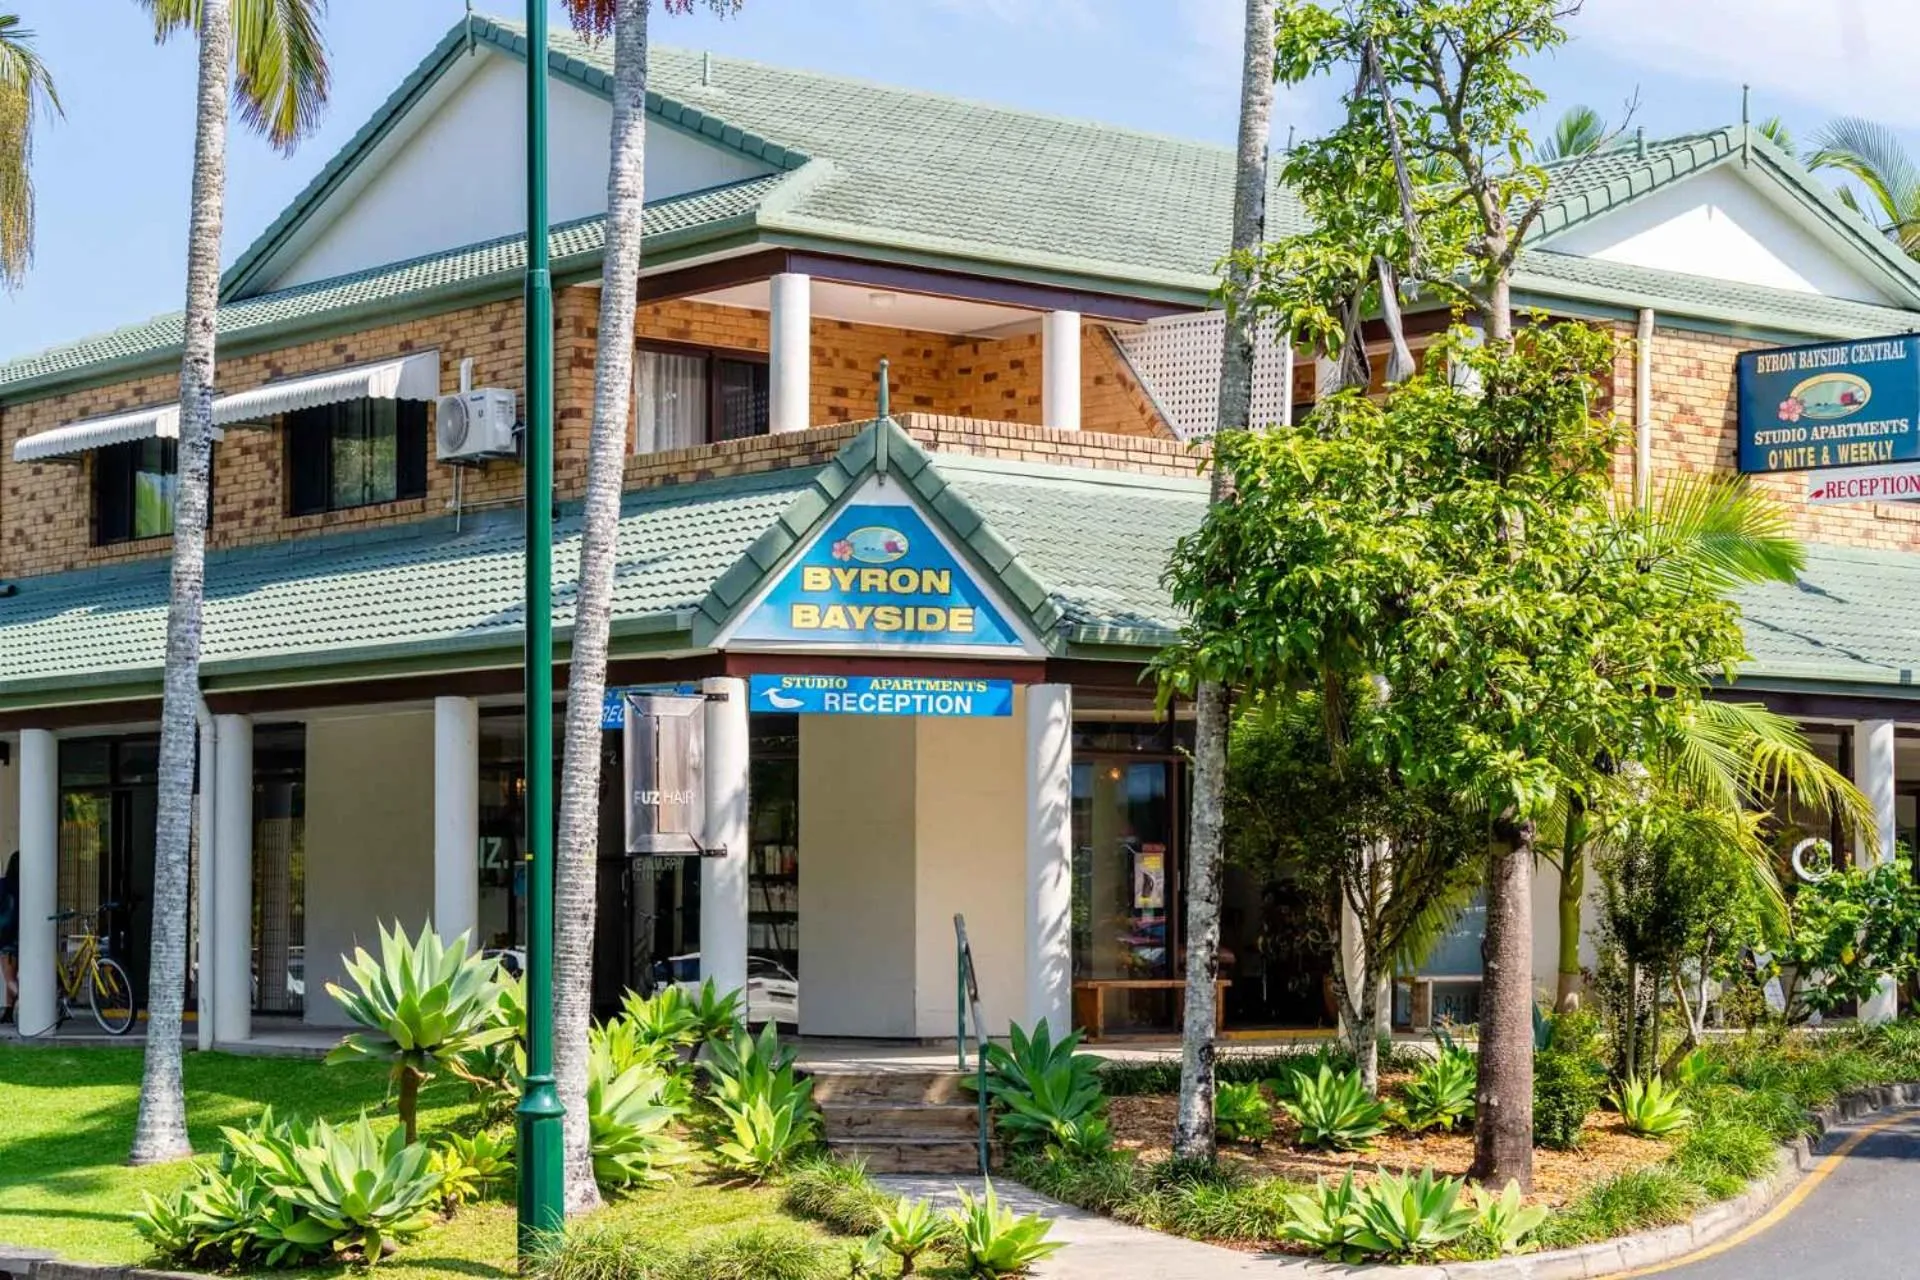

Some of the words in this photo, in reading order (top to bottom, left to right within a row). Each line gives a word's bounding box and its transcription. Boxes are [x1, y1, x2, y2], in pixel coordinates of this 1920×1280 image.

[1757, 352, 1796, 374] BYRON
[1799, 346, 1849, 369] BAYSIDE
[1851, 341, 1907, 364] CENTRAL
[1754, 427, 1807, 446] STUDIO
[1810, 418, 1909, 441] APARTMENTS
[1768, 446, 1816, 469] O'NITE
[1821, 445, 1830, 465] &
[1838, 440, 1894, 463] WEEKLY
[1826, 475, 1920, 499] RECEPTION
[802, 566, 950, 594] BYRON
[791, 603, 975, 633] BAYSIDE
[781, 676, 848, 690] STUDIO
[869, 678, 988, 693] APARTMENTS
[824, 692, 972, 714] RECEPTION
[634, 789, 660, 805] FUZ
[663, 789, 695, 805] HAIR
